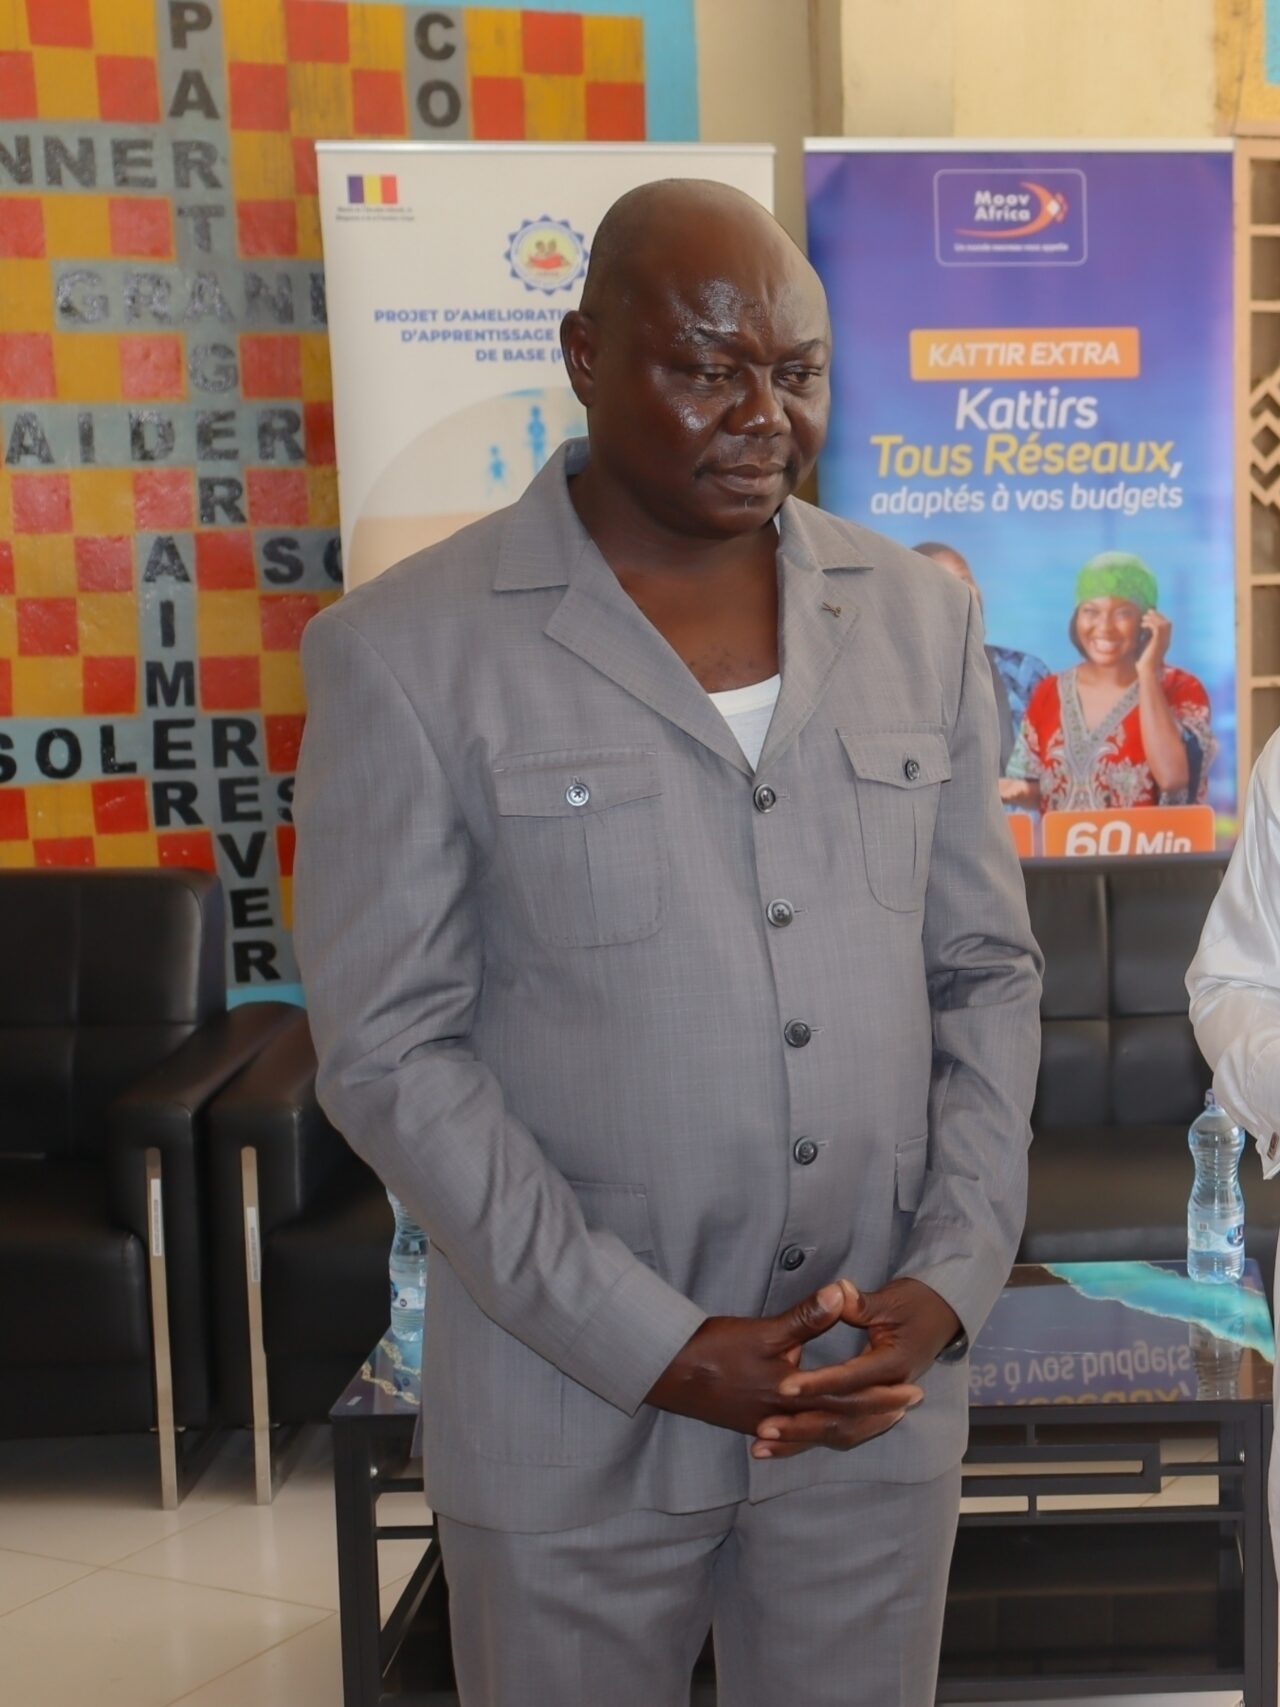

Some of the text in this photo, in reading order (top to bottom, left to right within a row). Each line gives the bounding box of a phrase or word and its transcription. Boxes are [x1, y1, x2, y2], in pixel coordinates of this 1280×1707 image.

[974, 190, 1030, 207] Moov
[974, 205, 1031, 222] Africa
[374, 309, 438, 323] PROJET
[475, 349, 497, 362] DE
[503, 348, 546, 362] BASE
[928, 341, 1121, 368] KATTIR EXTRA
[955, 386, 1099, 430] Kattirs
[5, 407, 305, 465] AIDER
[870, 433, 1183, 479] Tous Réseaux,
[870, 482, 1183, 518] adaptés à vos budgets
[142, 535, 204, 827] AIMER
[1064, 820, 1192, 857] 60 Min
